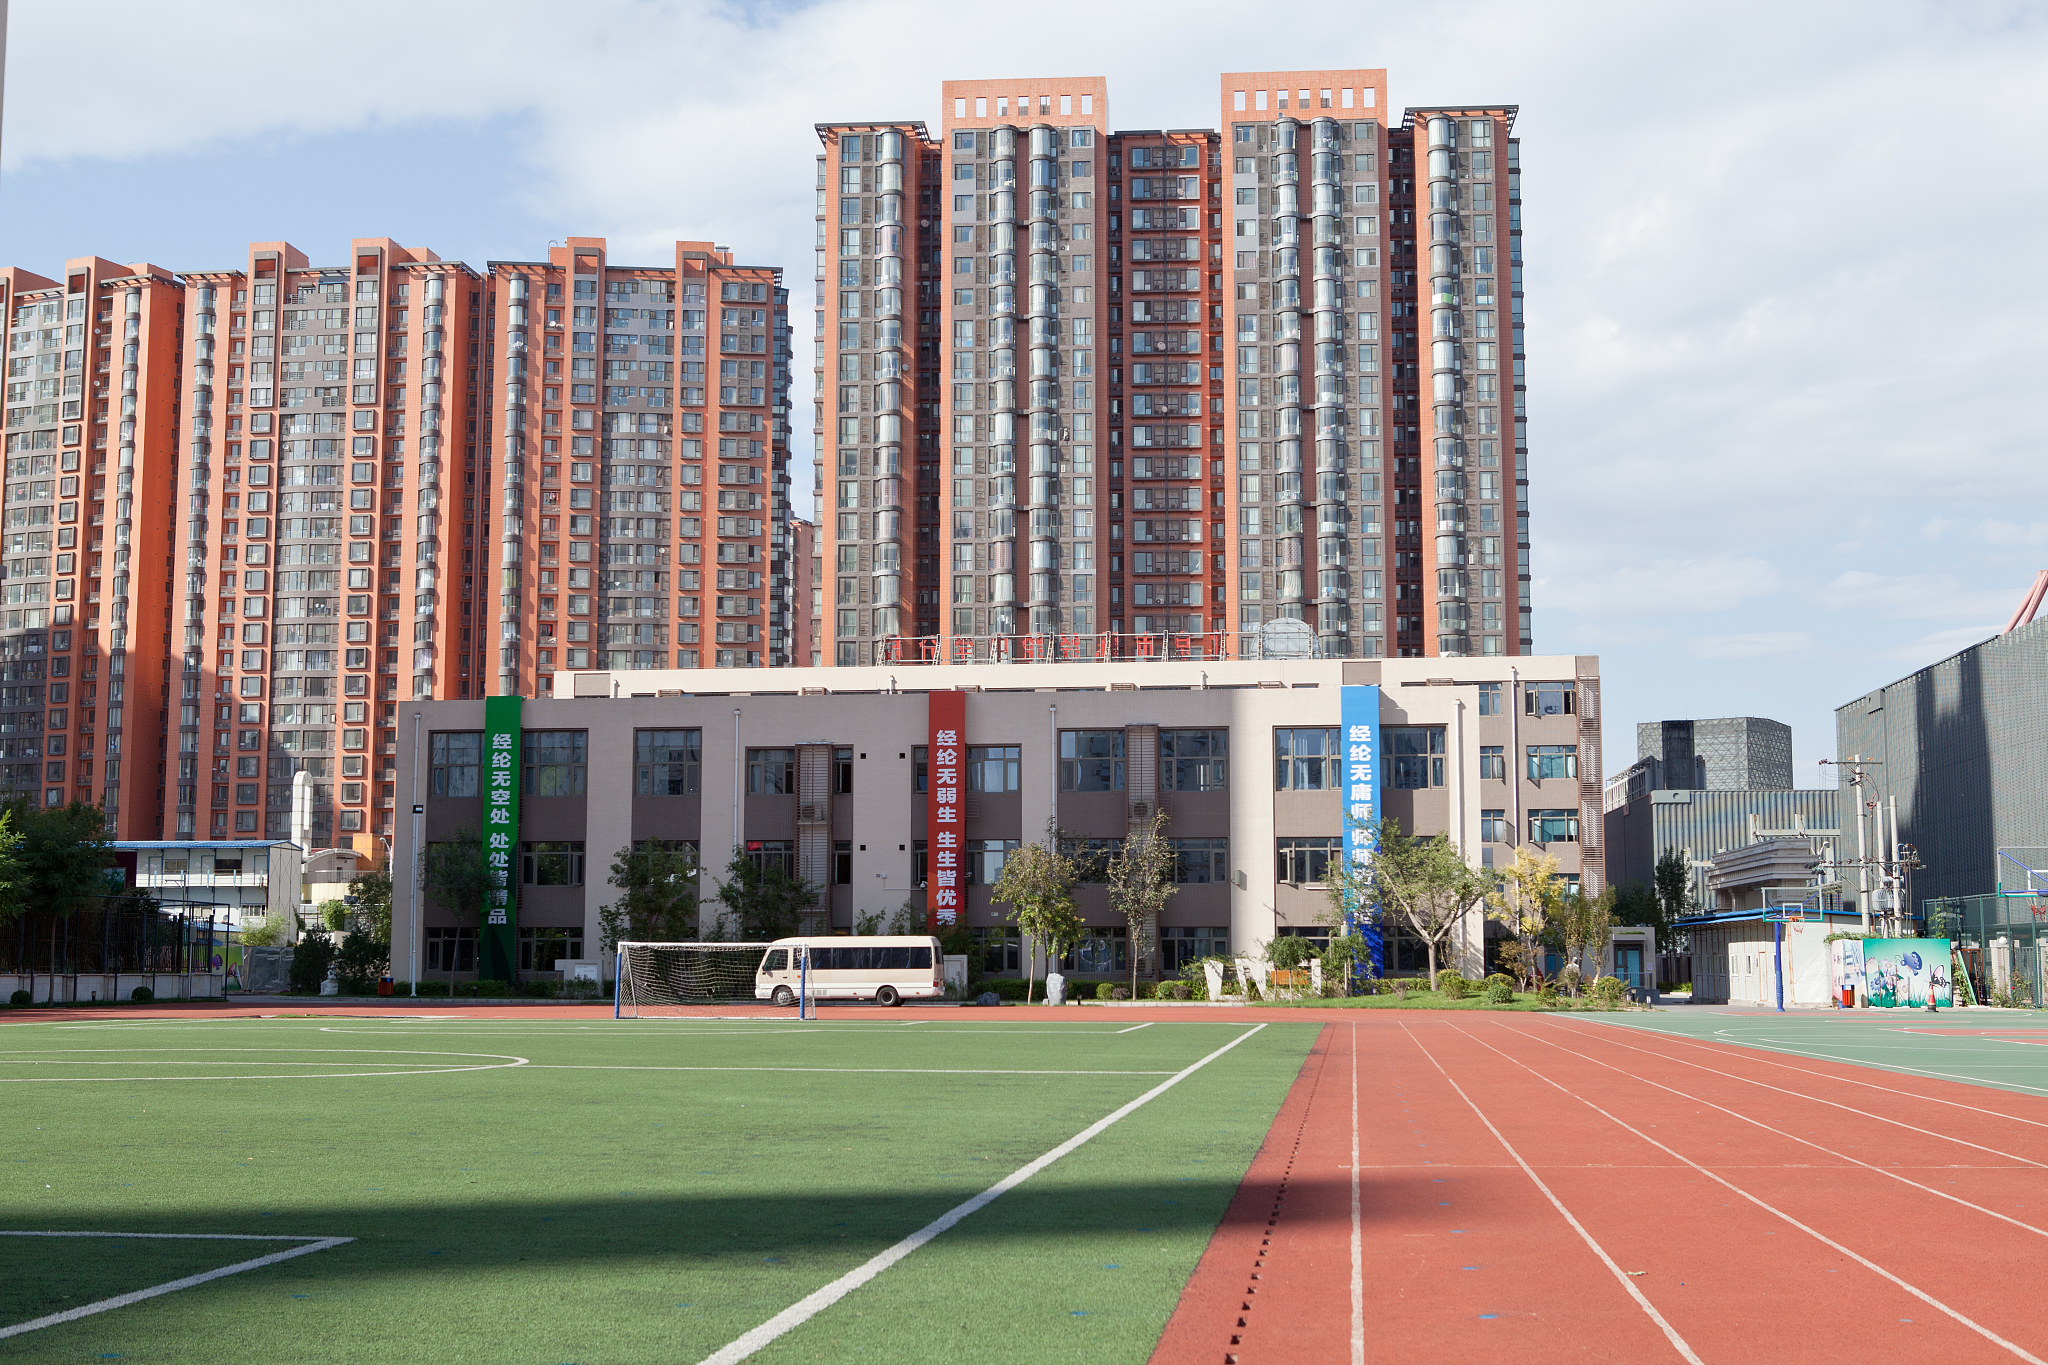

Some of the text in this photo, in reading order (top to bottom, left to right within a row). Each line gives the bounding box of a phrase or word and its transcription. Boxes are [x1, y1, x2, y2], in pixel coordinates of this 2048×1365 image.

[490, 733, 512, 824] 经纶无空处
[1349, 725, 1373, 820] 经纶无庸师
[936, 729, 957, 926] 经纶无弱生 生生皆优秀
